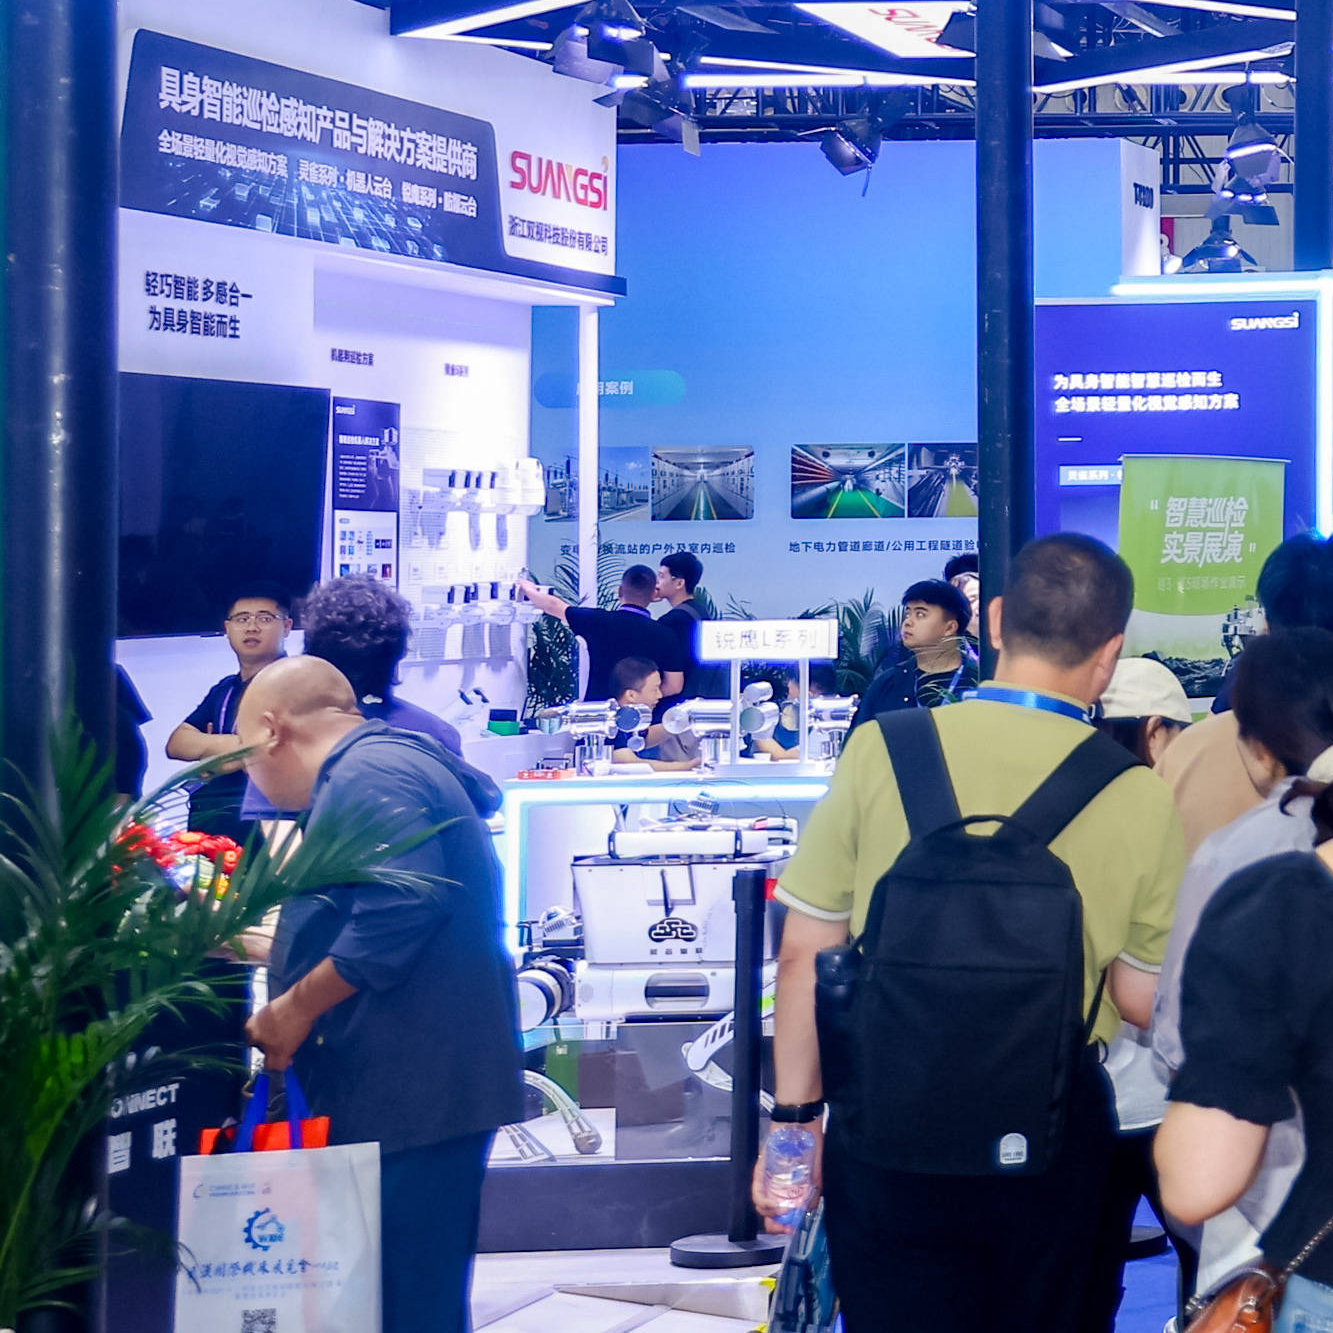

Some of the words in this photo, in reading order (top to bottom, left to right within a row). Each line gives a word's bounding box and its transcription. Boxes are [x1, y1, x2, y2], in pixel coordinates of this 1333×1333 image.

[158, 65, 478, 181] 具身智能巡检感知产品与解决方案提供商
[145, 270, 199, 302] 轻巧智能
[202, 277, 253, 307] 多感合一
[148, 305, 241, 339] 为具身智能而生
[789, 539, 978, 554] 地下电力管道廊道/公用工程隧道验
[110, 1083, 181, 1118] ONNECT
